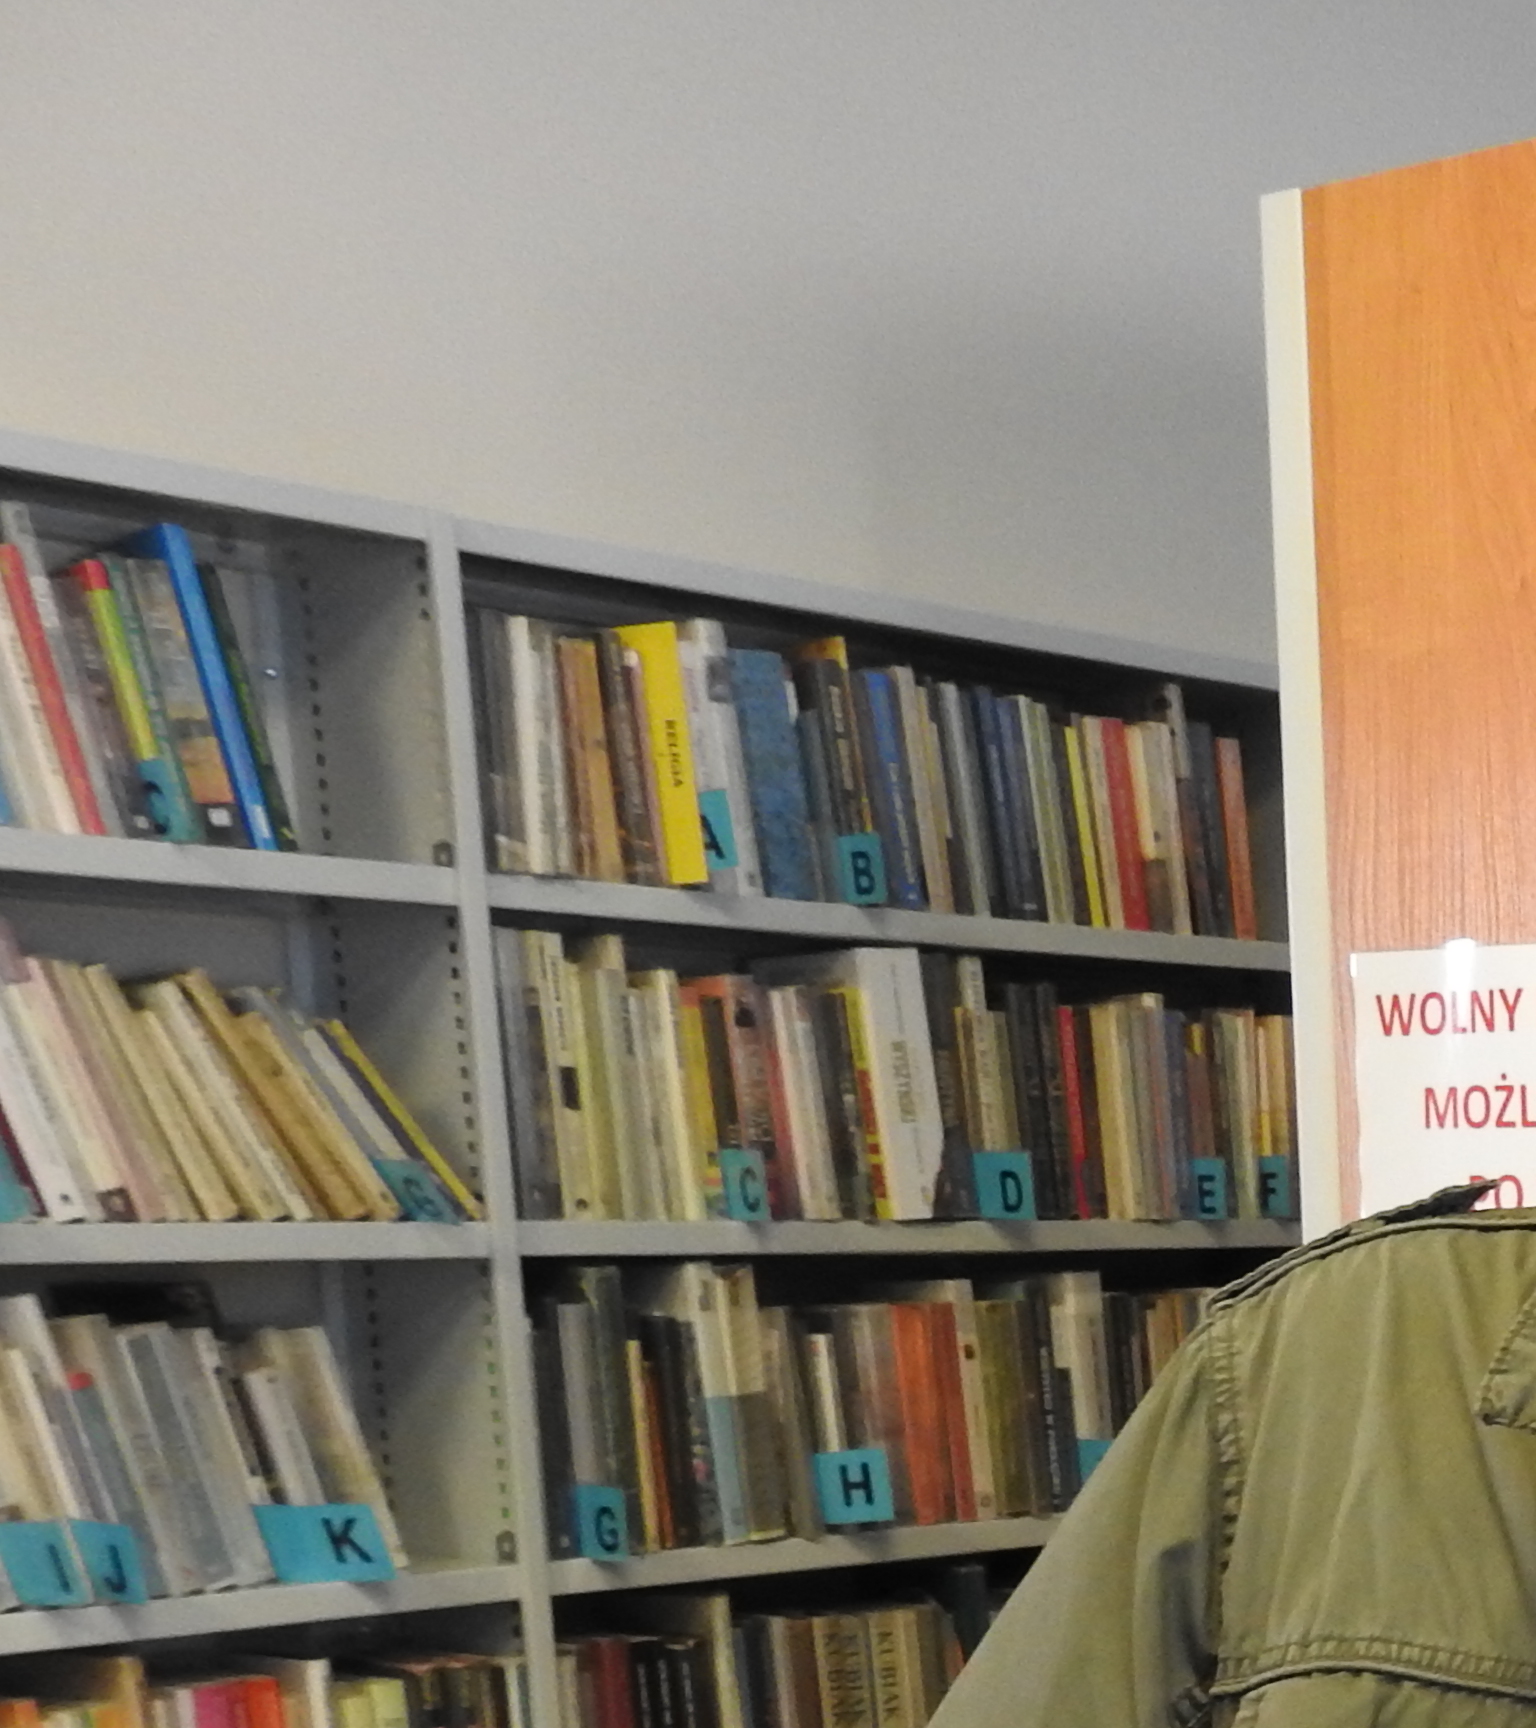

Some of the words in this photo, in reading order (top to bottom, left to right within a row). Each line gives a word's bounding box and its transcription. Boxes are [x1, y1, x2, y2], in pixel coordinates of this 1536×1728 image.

[850, 850, 875, 897] B
[1375, 987, 1523, 1037] WOLNY
[739, 1165, 761, 1213] C
[1001, 1169, 1024, 1213] D
[1198, 1174, 1217, 1213] E
[838, 1459, 876, 1508] H
[320, 1517, 376, 1565] K
[103, 1550, 128, 1595] J
